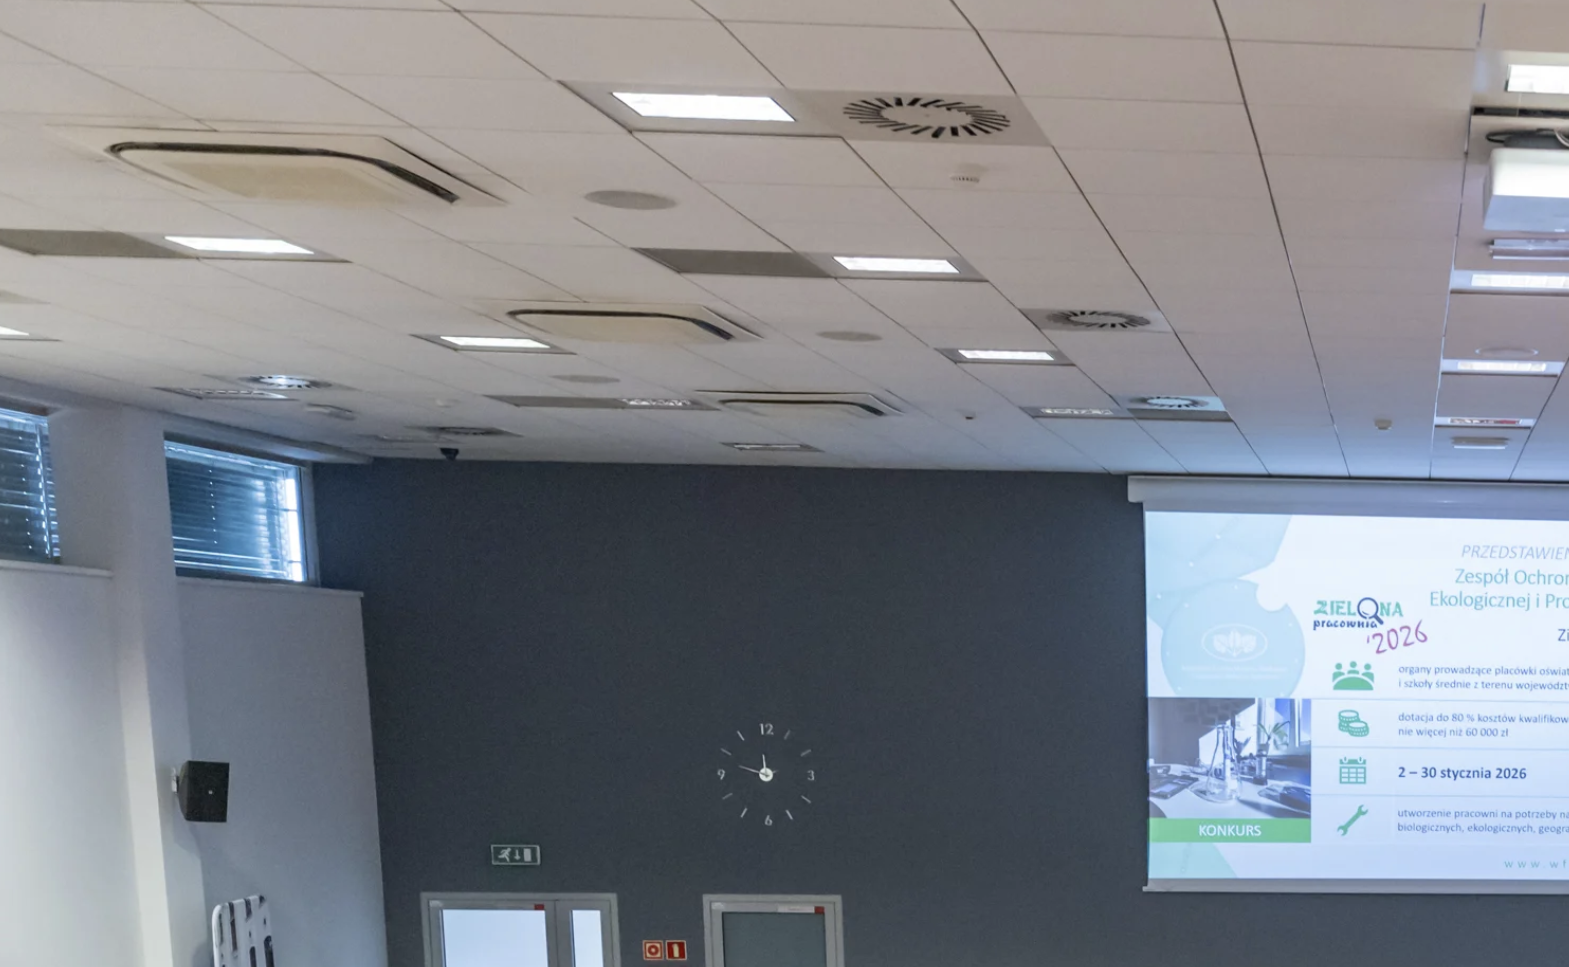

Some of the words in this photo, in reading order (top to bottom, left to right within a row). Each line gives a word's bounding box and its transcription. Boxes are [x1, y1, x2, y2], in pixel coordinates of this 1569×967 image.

[1454, 568, 1509, 588] Zespół
[1430, 591, 1531, 611] Ekologicznej
[1536, 593, 1540, 608] i
[1313, 620, 1378, 631] pracownia
[1398, 666, 1432, 676] organy
[1434, 666, 1492, 676] prowadzące
[1495, 666, 1537, 676] placówki
[1404, 680, 1432, 690] szkoły
[1436, 680, 1470, 689] średnie
[1482, 681, 1513, 690] terenu
[1398, 712, 1434, 724] dotacja
[1436, 712, 1448, 722] do
[1452, 713, 1464, 722] 80
[1466, 714, 1474, 722] %
[1478, 714, 1516, 722] kosztów
[760, 723, 774, 735] 12
[1398, 728, 1413, 736] nie
[1416, 728, 1446, 738] więcej
[1450, 728, 1463, 737] niż
[1466, 728, 1478, 737] 60
[1480, 728, 1498, 737] 000
[1500, 728, 1509, 738] zł
[717, 768, 726, 780] 9
[807, 770, 814, 780] 3
[1398, 766, 1406, 778] 2
[1420, 766, 1436, 778] 30
[1440, 767, 1492, 781] stycznia
[1495, 767, 1527, 780] 2026
[1398, 809, 1451, 818] utworzenie
[1454, 808, 1498, 820] pracowni
[1515, 809, 1557, 820] potrzeby
[764, 815, 772, 826] 6
[1198, 824, 1262, 837] KONKURS
[1398, 822, 1464, 834] biologicznych,
[1468, 823, 1536, 834] ekologicznych,
